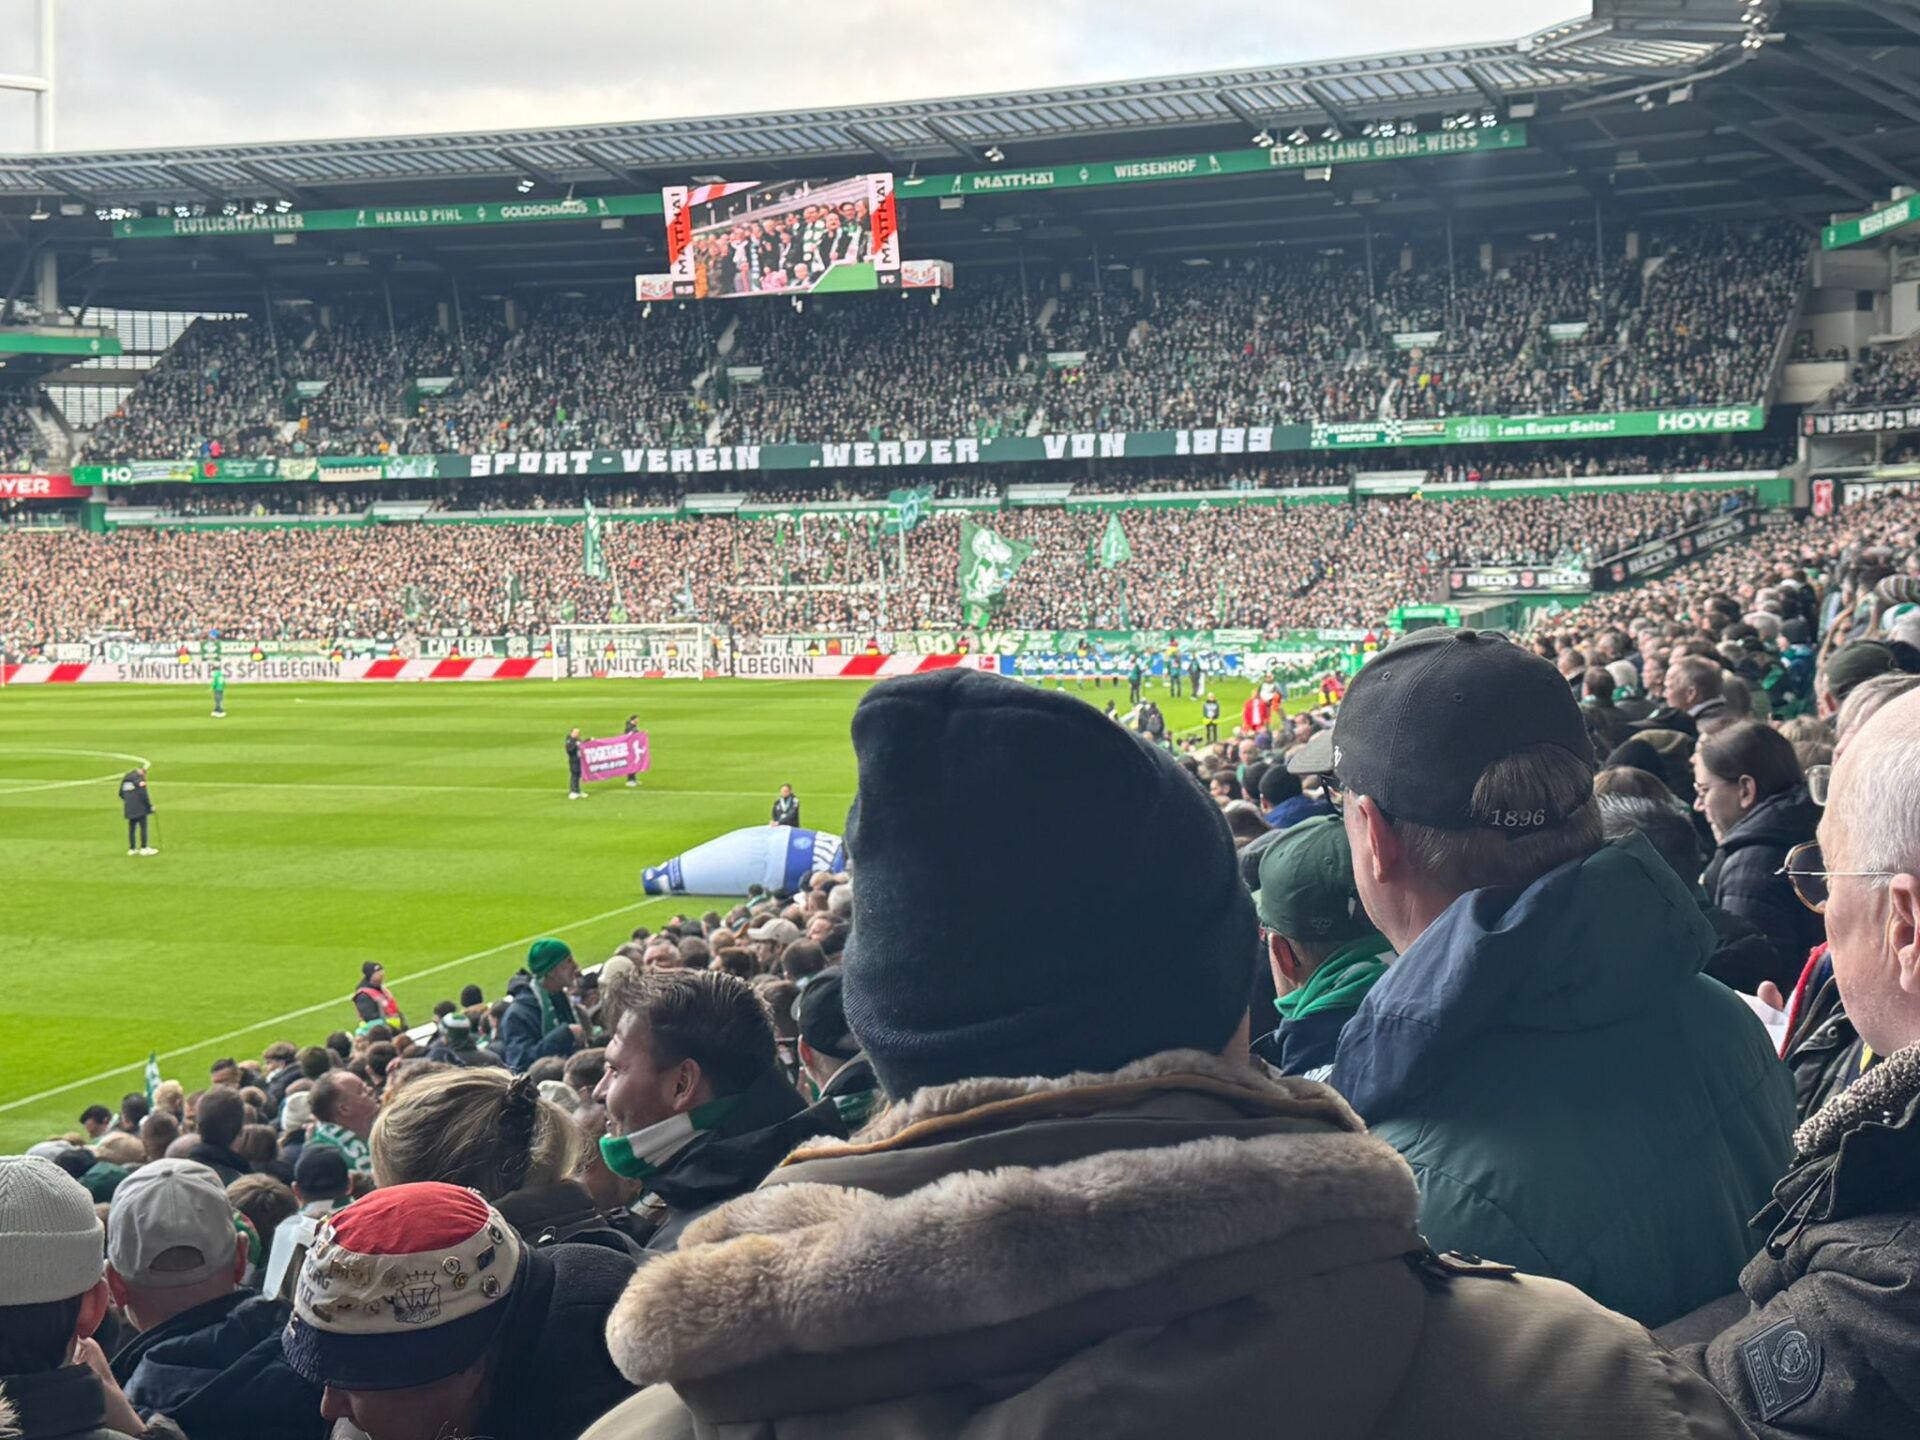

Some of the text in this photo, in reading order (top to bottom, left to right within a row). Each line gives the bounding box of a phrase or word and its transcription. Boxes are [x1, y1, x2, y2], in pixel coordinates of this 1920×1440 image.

[1270, 142, 1369, 165] LEBENSLANG
[1114, 159, 1197, 178] WIESENHOF
[174, 213, 304, 233] FLUTLICHTPARTNER
[375, 206, 463, 224] HARALD PIHL
[1658, 409, 1752, 431] HOYER
[1043, 433, 1126, 459] VON
[1176, 427, 1273, 455] 1899
[0, 478, 50, 495] YER
[118, 659, 340, 679] 5 MINUTEN BS SPIELBEGINN
[1491, 809, 1545, 827] 1896
